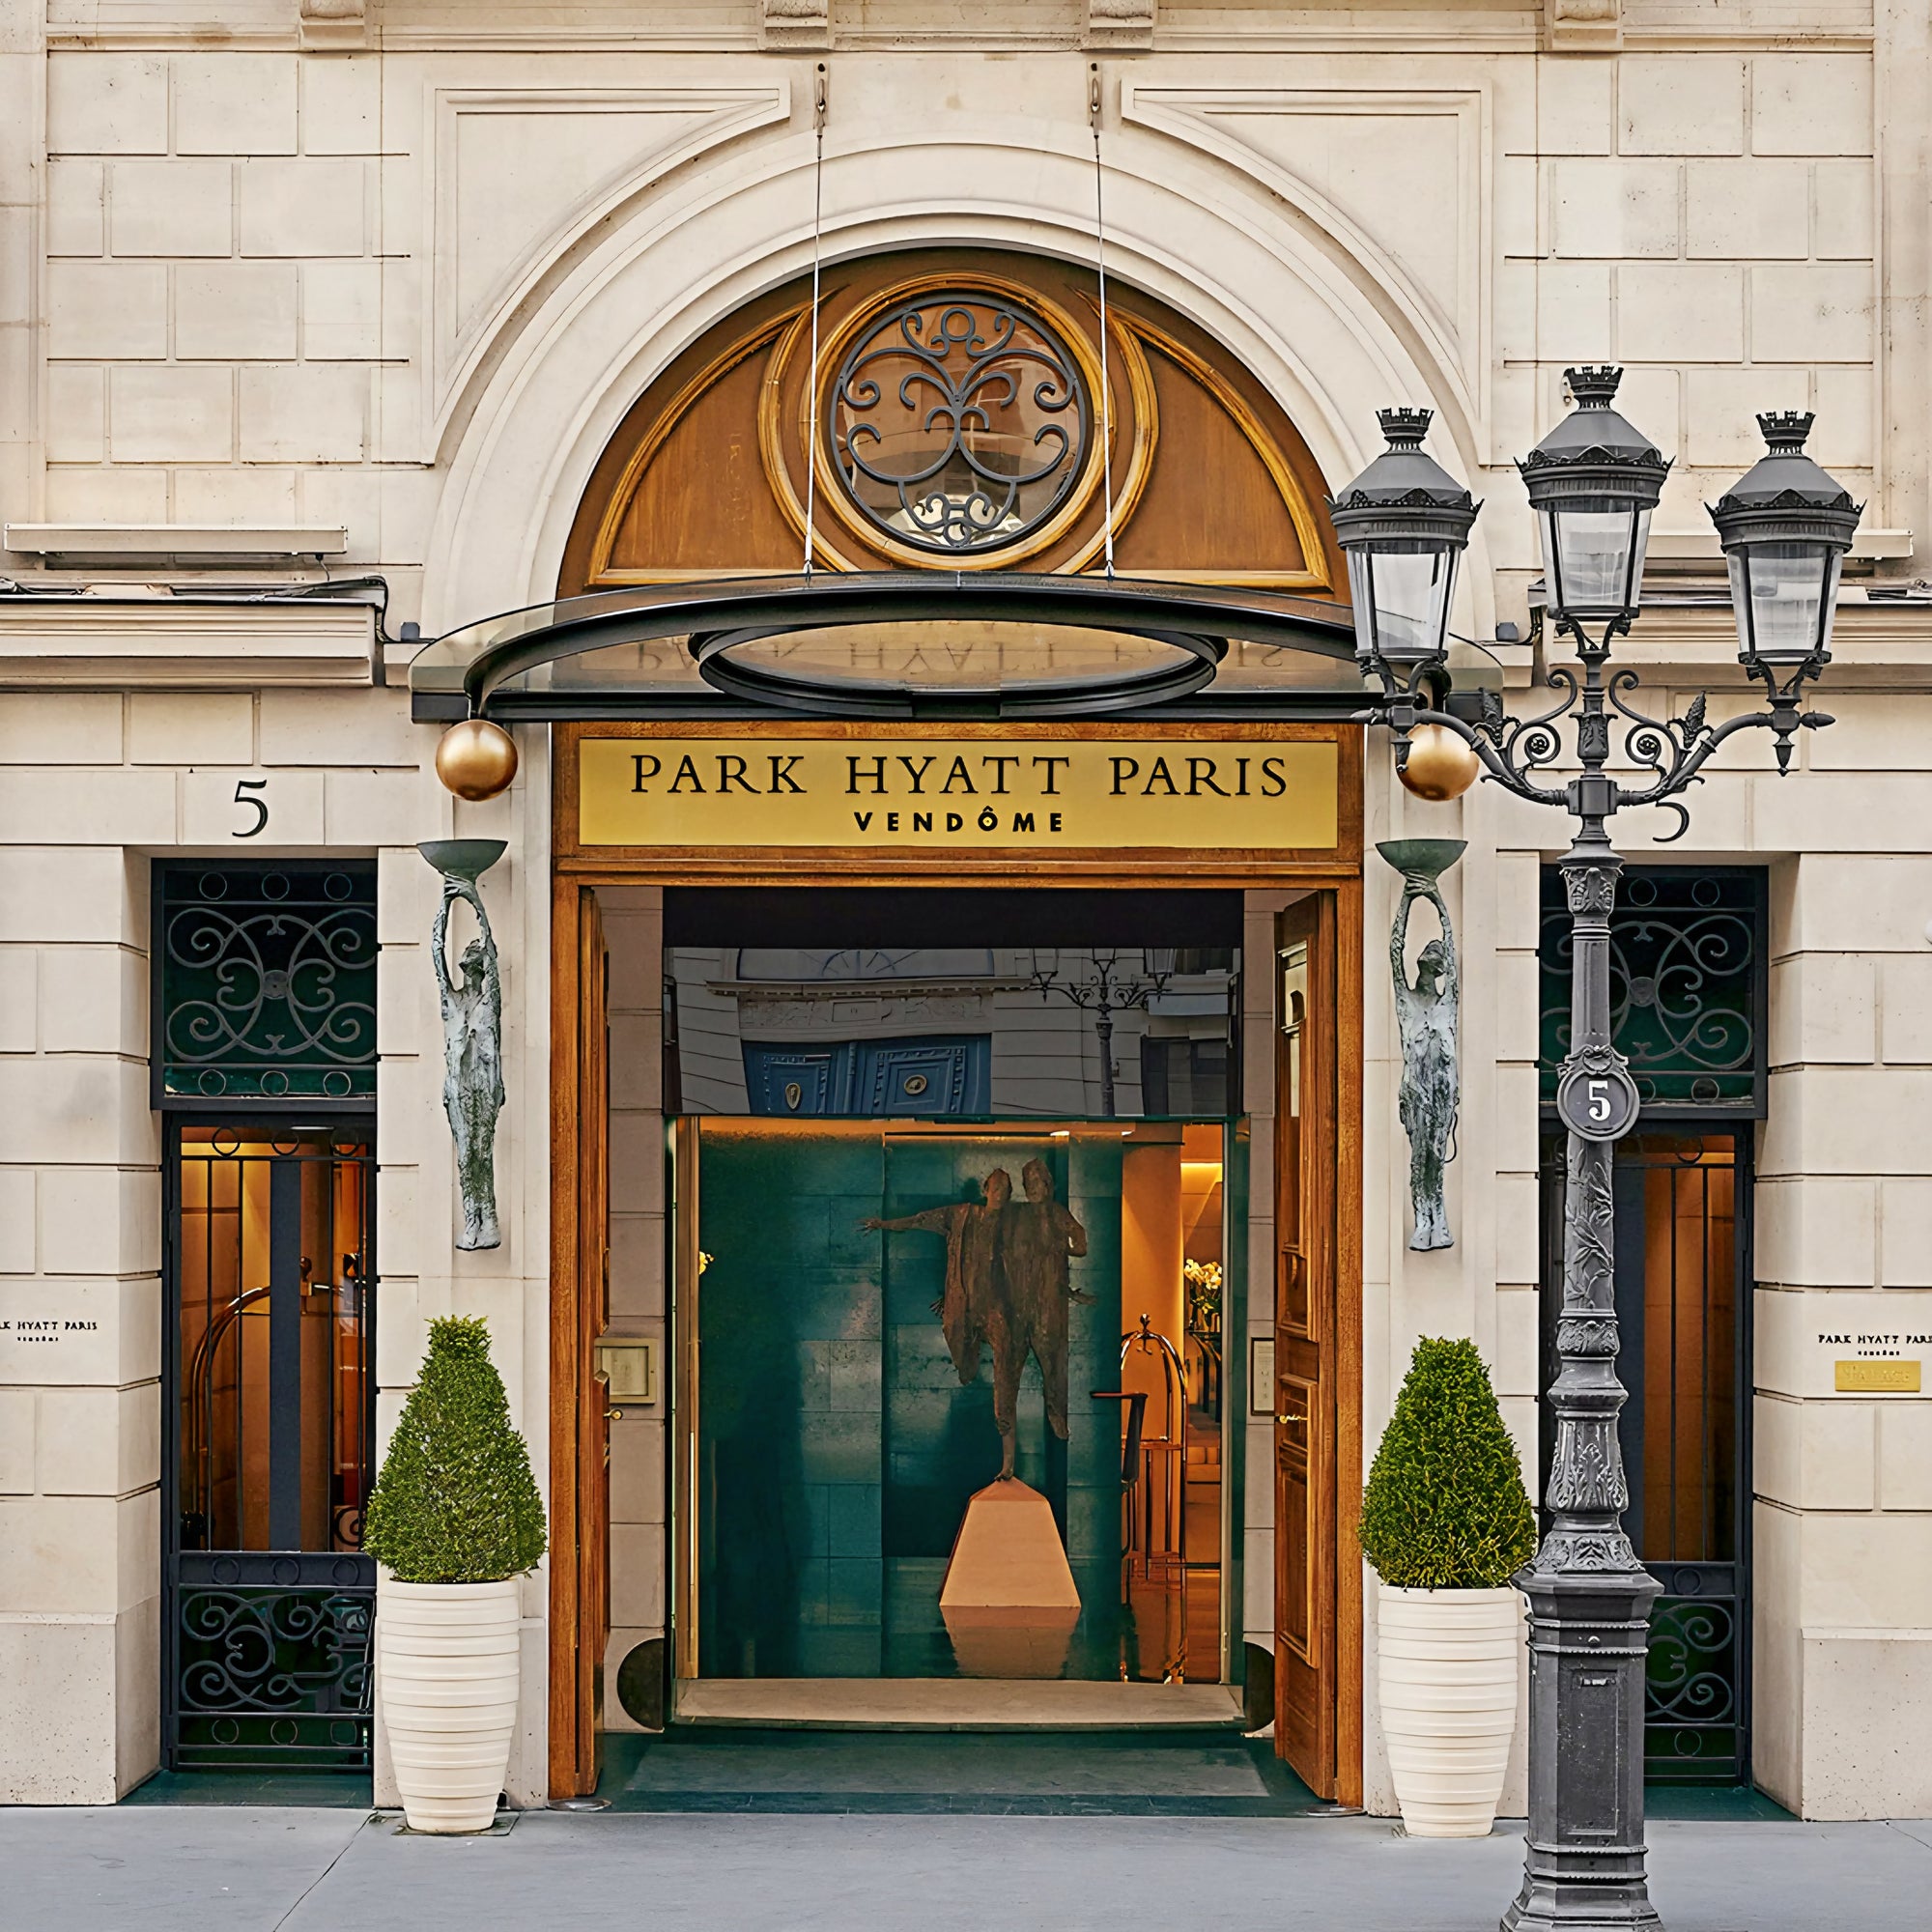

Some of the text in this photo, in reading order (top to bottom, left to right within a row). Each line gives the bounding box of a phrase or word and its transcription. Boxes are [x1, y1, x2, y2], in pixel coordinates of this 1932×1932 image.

[630, 754, 1287, 798] PARK HYATT PARIS
[231, 779, 269, 838] 5
[853, 805, 1062, 833] VENDÔME
[1588, 1080, 1611, 1122] 5
[16, 1321, 59, 1330] HYATT
[64, 1321, 98, 1330] PARIS
[1818, 1334, 1852, 1344] PARK
[1857, 1334, 1899, 1344] HYATT
